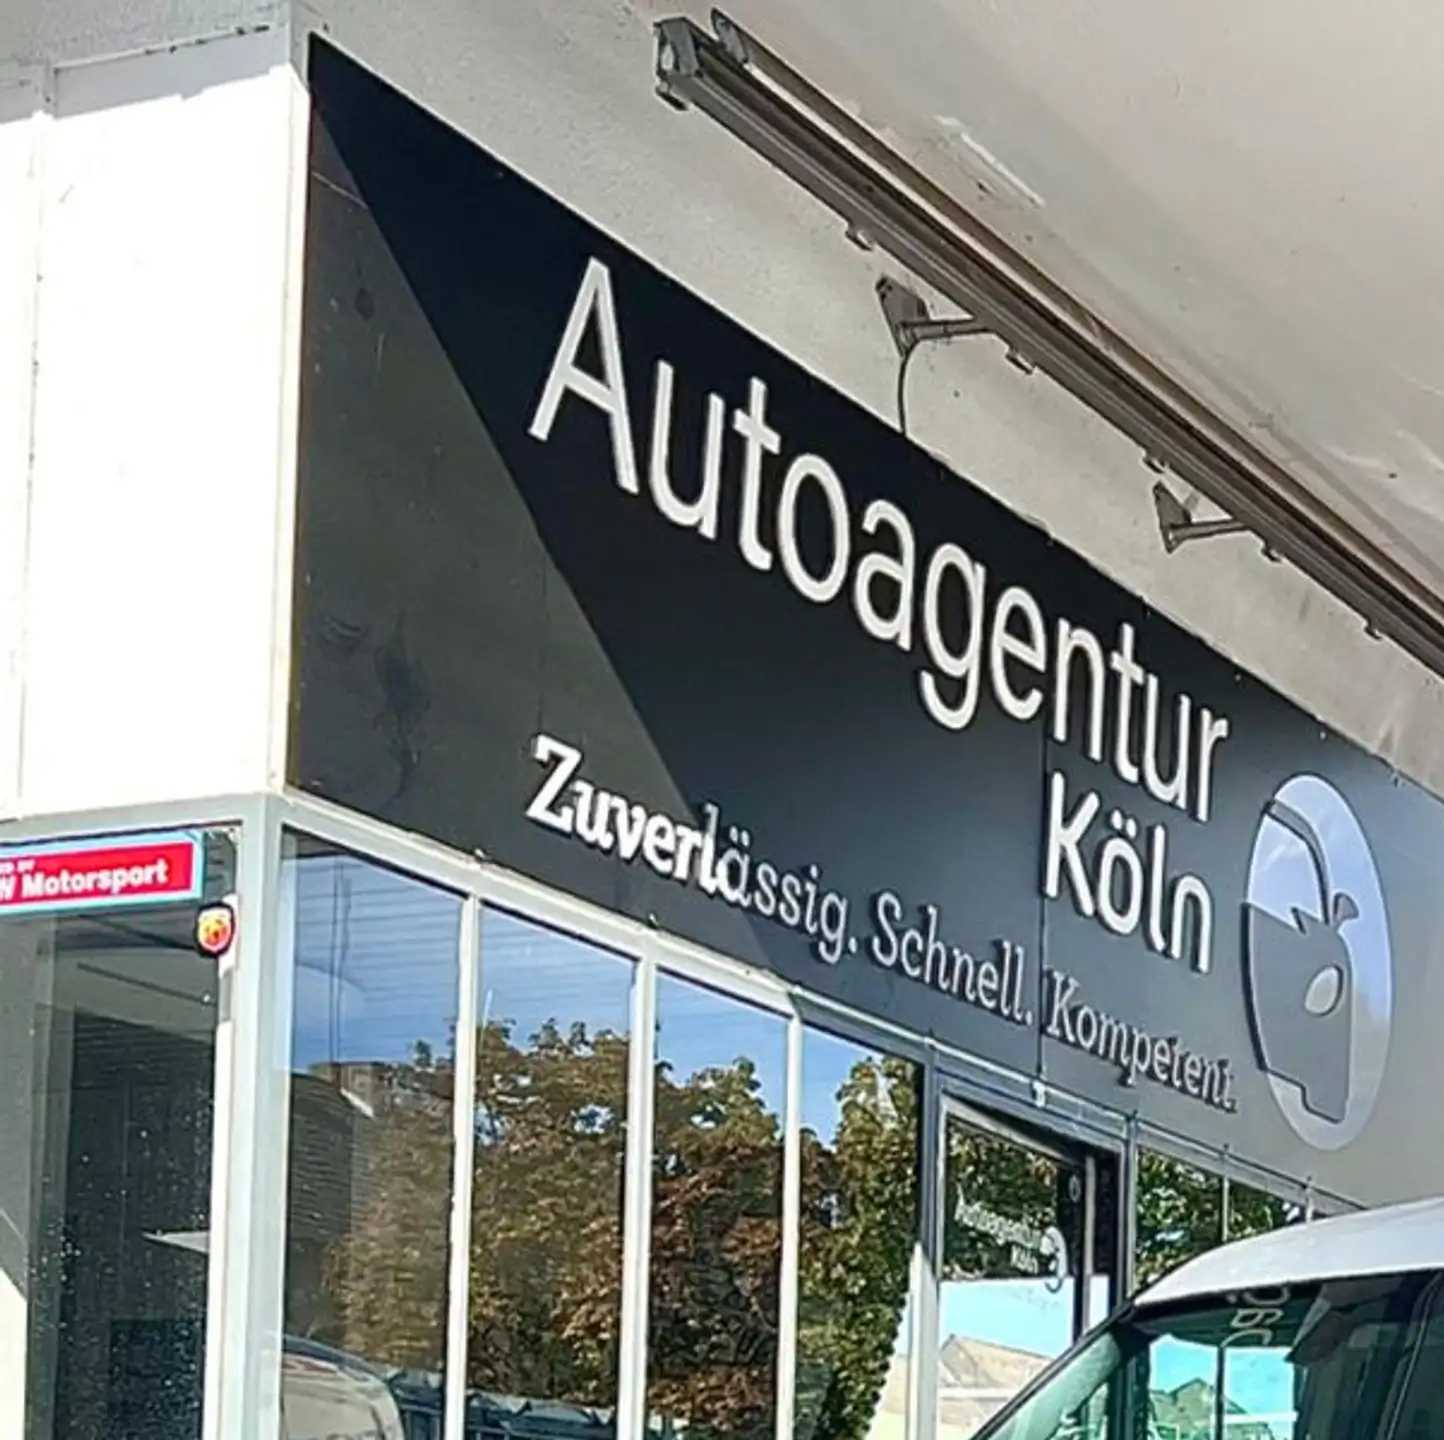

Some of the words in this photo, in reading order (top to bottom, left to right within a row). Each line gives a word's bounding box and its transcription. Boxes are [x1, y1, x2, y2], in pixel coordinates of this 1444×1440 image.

[529, 257, 1228, 821] Autoagentur
[21, 858, 168, 898] Motorsport
[526, 733, 858, 965] Zuverlässig.
[872, 891, 1035, 1027] Schnell.
[1045, 968, 1238, 1113] Kompetent.
[1044, 770, 1213, 974] Köln
